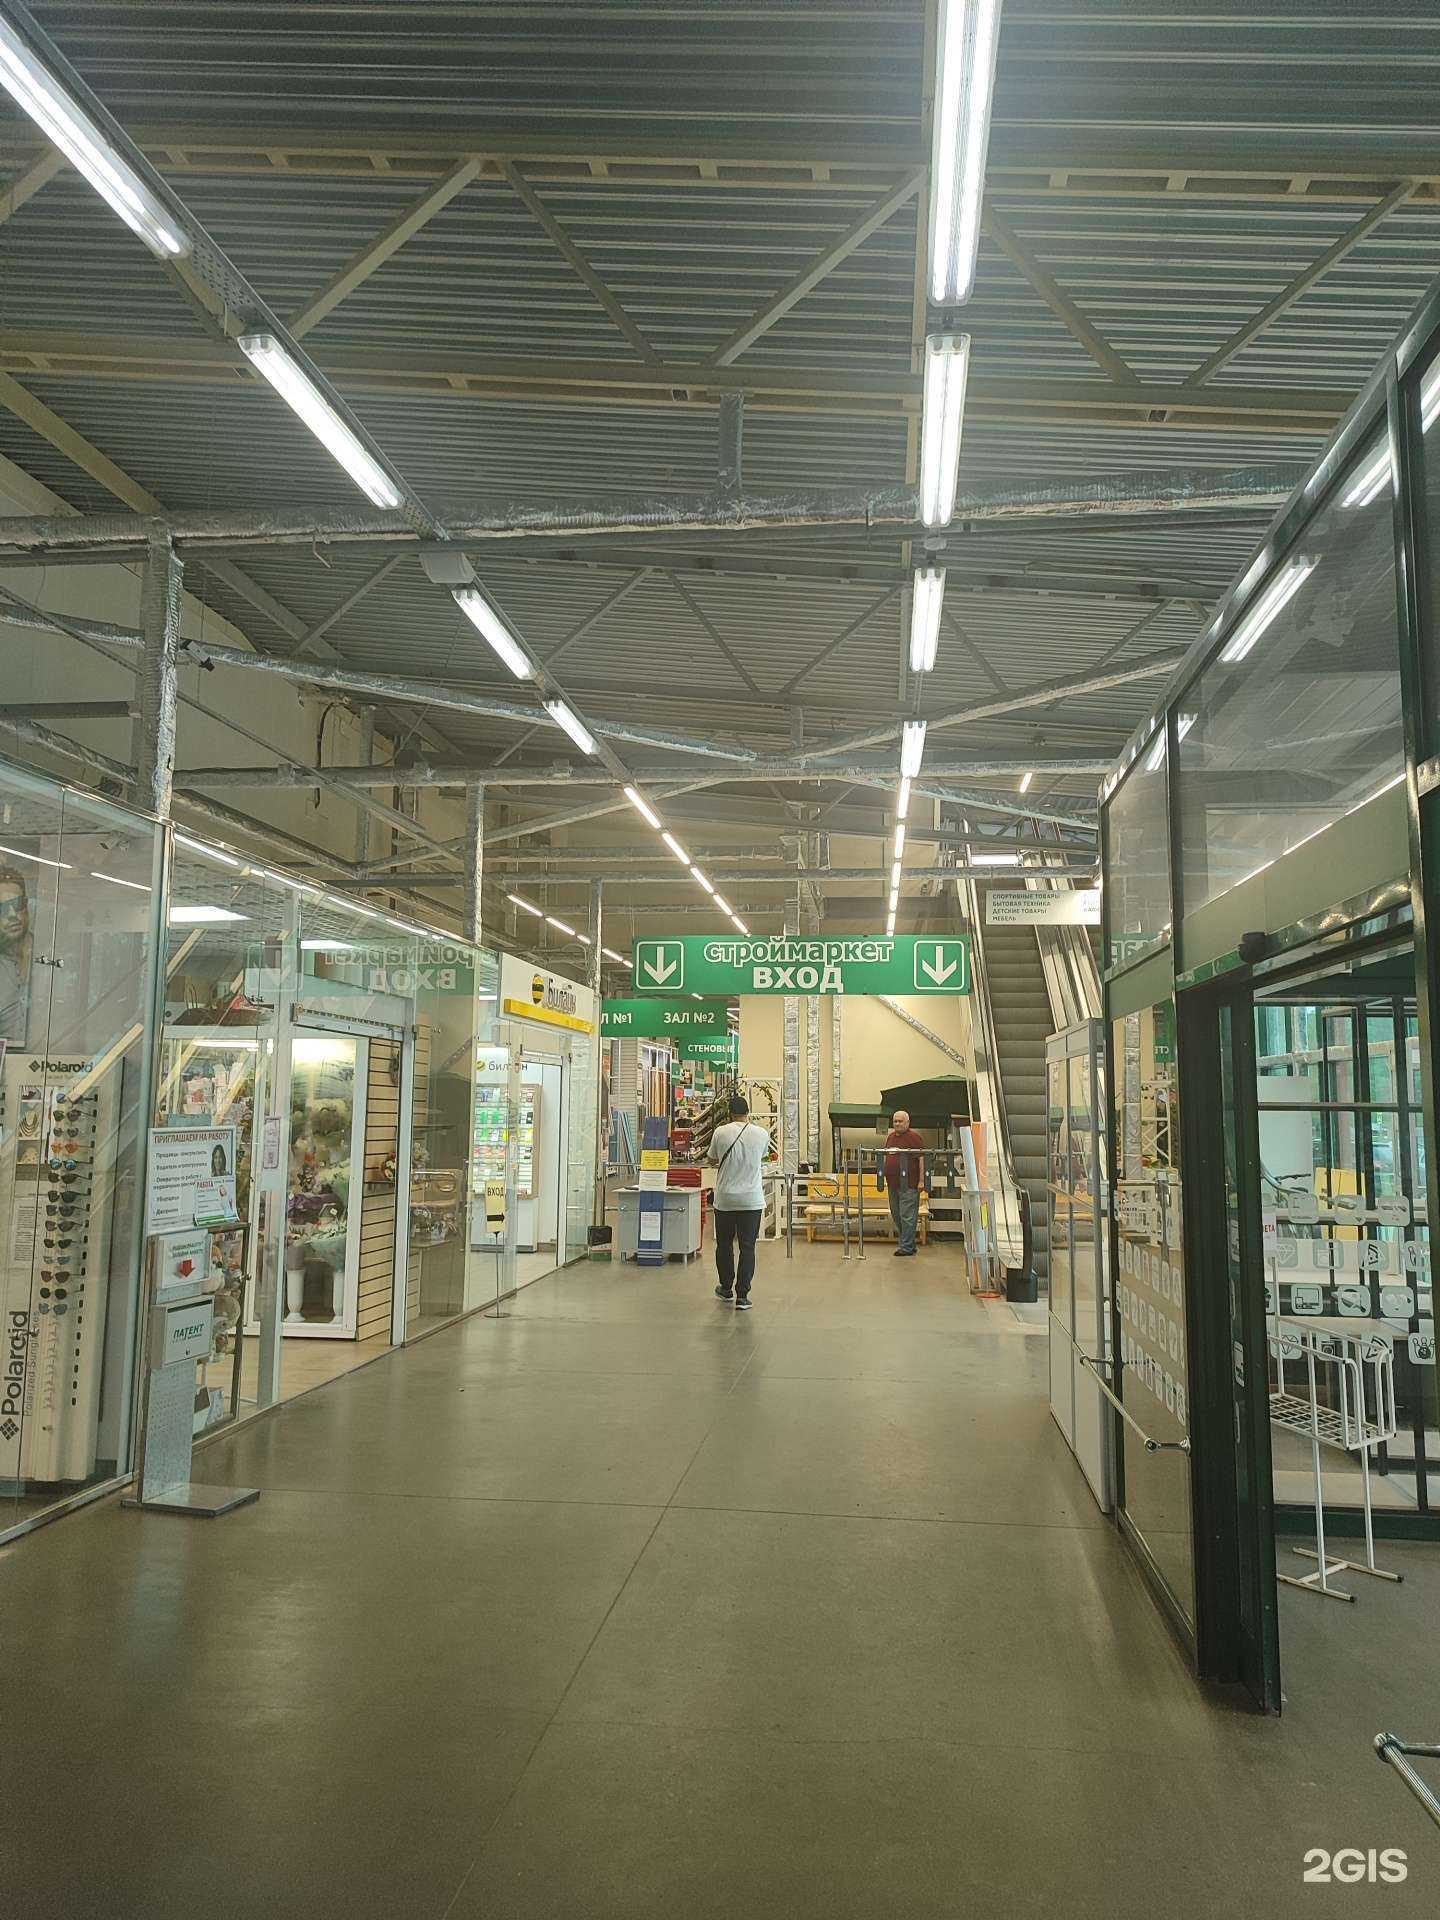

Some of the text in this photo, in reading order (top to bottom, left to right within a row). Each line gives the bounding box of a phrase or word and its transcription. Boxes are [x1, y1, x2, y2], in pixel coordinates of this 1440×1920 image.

[704, 936, 894, 967] строймаркет
[613, 1012, 633, 1024] №1
[663, 1012, 715, 1024] ЗАЛ №2
[41, 1060, 94, 1073] Polaroid
[488, 1060, 528, 1071] билн
[154, 1131, 229, 1144] ПРИГЛАШАЕМ НА РАБОТУ
[487, 1187, 504, 1198] ВХОД
[173, 1323, 205, 1340] ПАТЕНТ
[1, 1311, 28, 1416] Polaroid
